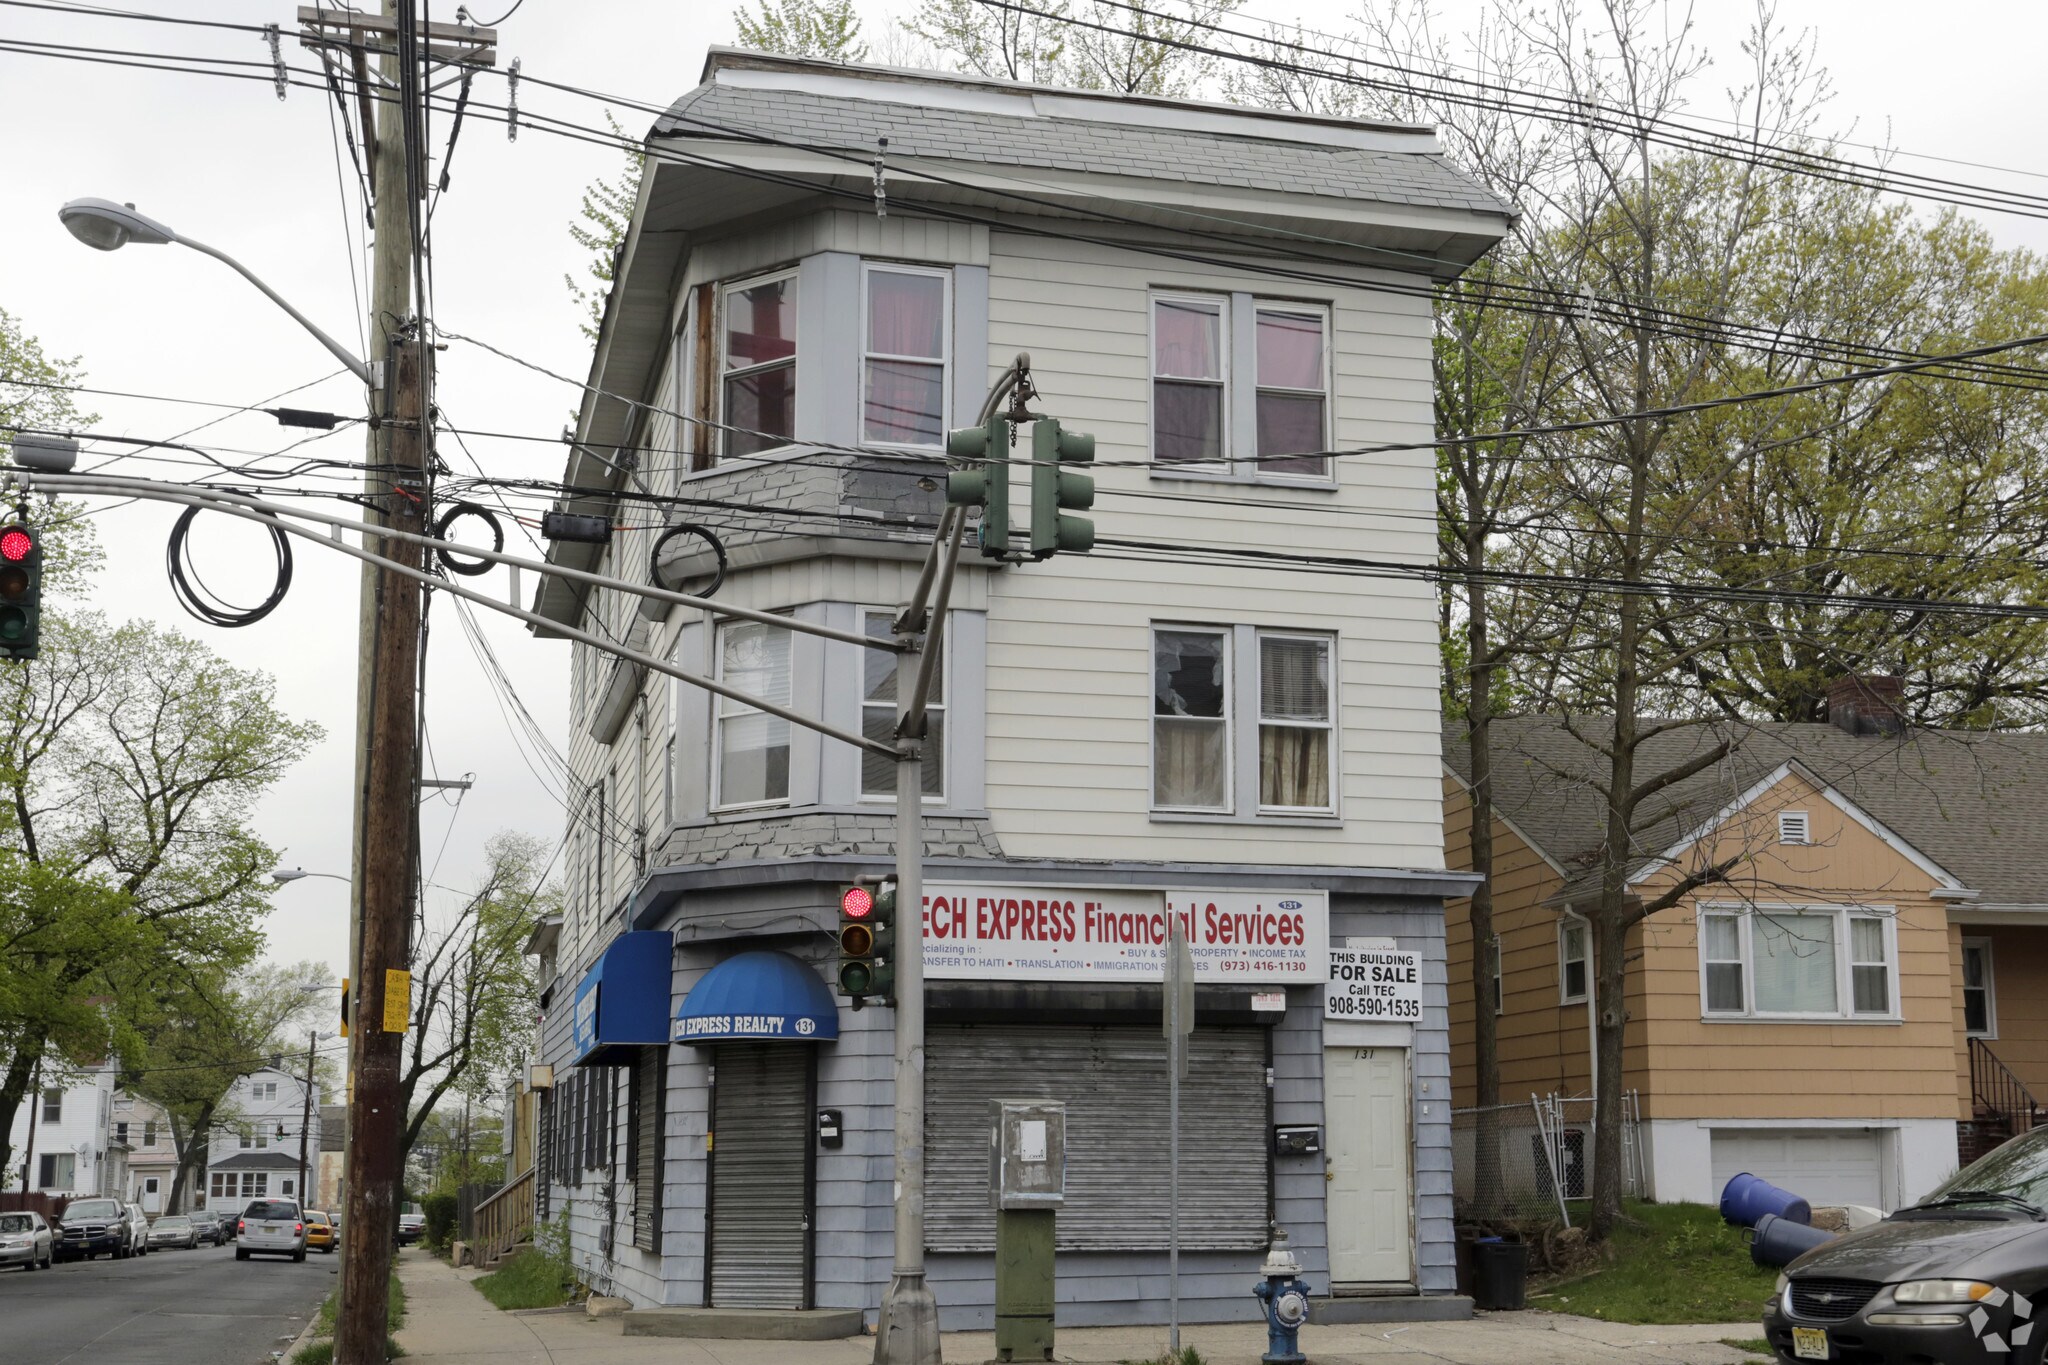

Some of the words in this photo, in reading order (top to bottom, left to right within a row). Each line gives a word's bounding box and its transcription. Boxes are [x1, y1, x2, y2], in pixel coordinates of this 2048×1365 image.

[1281, 901, 1299, 910] 131
[977, 898, 1076, 943] EXPRESS
[1205, 902, 1304, 946] Services
[967, 945, 976, 954] in
[1127, 949, 1148, 958] BUY
[1150, 949, 1157, 958] &
[1249, 949, 1286, 958] INCOME
[1289, 949, 1306, 958] TAX
[963, 957, 976, 967] TO
[979, 958, 1005, 967] HAITI
[1015, 959, 1084, 969] TRANSLATION
[1329, 952, 1356, 963] THIS
[1360, 953, 1414, 966] BUILDING
[1094, 961, 1158, 970] IMMIGRATION
[1220, 960, 1250, 972] (973)
[1253, 961, 1306, 972] 416-1130
[1330, 965, 1366, 981] FOR
[1371, 966, 1417, 983] SALE
[1349, 984, 1370, 996] Call
[1373, 985, 1396, 997] TEC
[1329, 996, 1419, 1017] 908-590-1535
[686, 1015, 731, 1035] EXPRESS
[734, 1016, 785, 1034] REALTY
[796, 1018, 814, 1032] 131
[1354, 1049, 1375, 1060] 131
